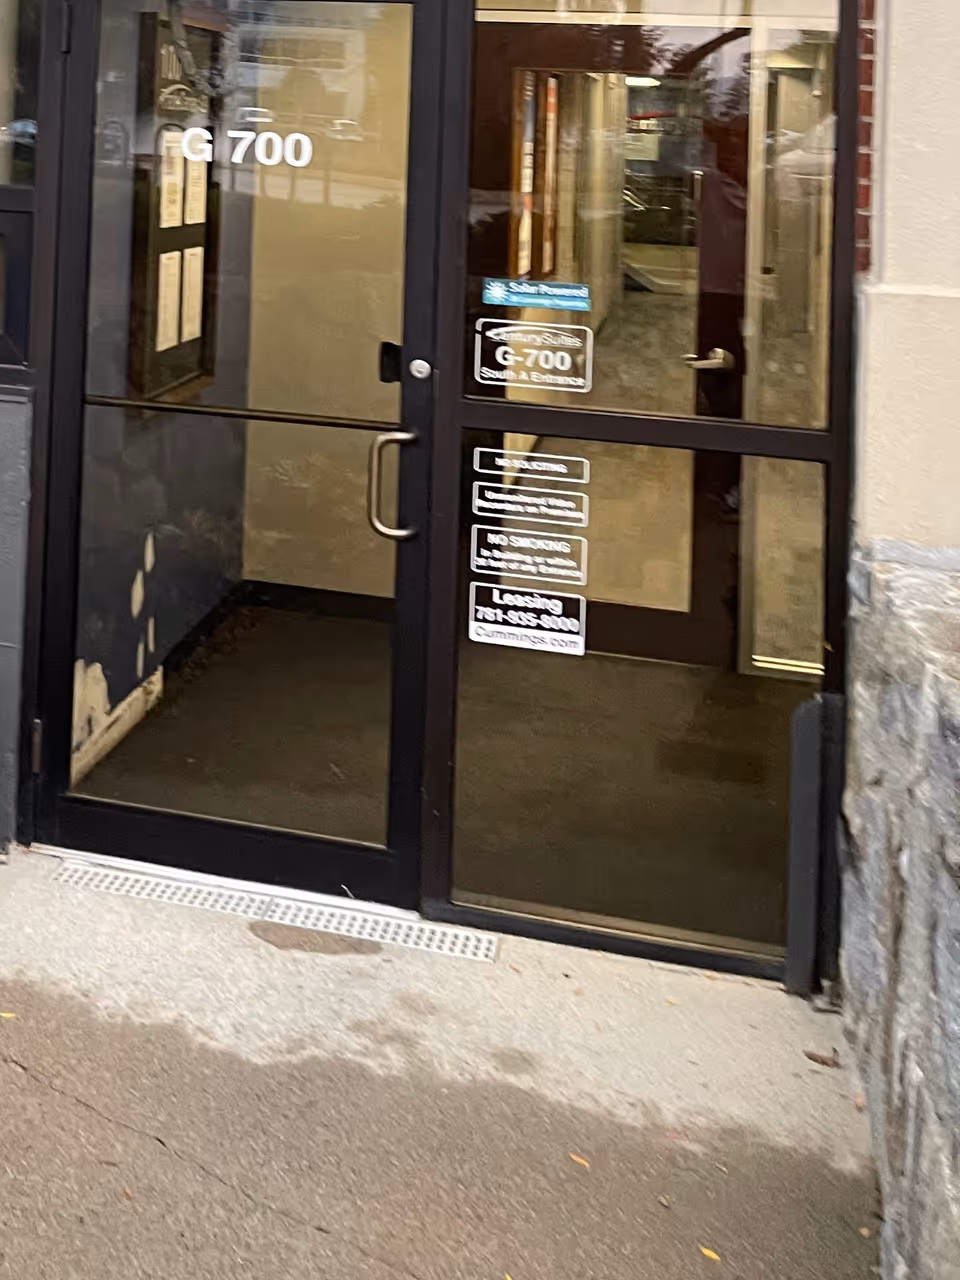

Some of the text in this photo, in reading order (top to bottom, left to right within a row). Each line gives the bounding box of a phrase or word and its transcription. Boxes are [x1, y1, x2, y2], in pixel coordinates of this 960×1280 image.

[181, 127, 313, 167] G 700
[508, 282, 589, 298] Solar Powered
[489, 331, 582, 347] CenturySuites
[495, 346, 572, 371] G-700
[480, 367, 586, 387] South A Entrance
[495, 457, 512, 468] NO
[487, 532, 571, 553] NO SMOKING
[492, 589, 563, 615] Leasing
[475, 625, 580, 647] Cummings.com
